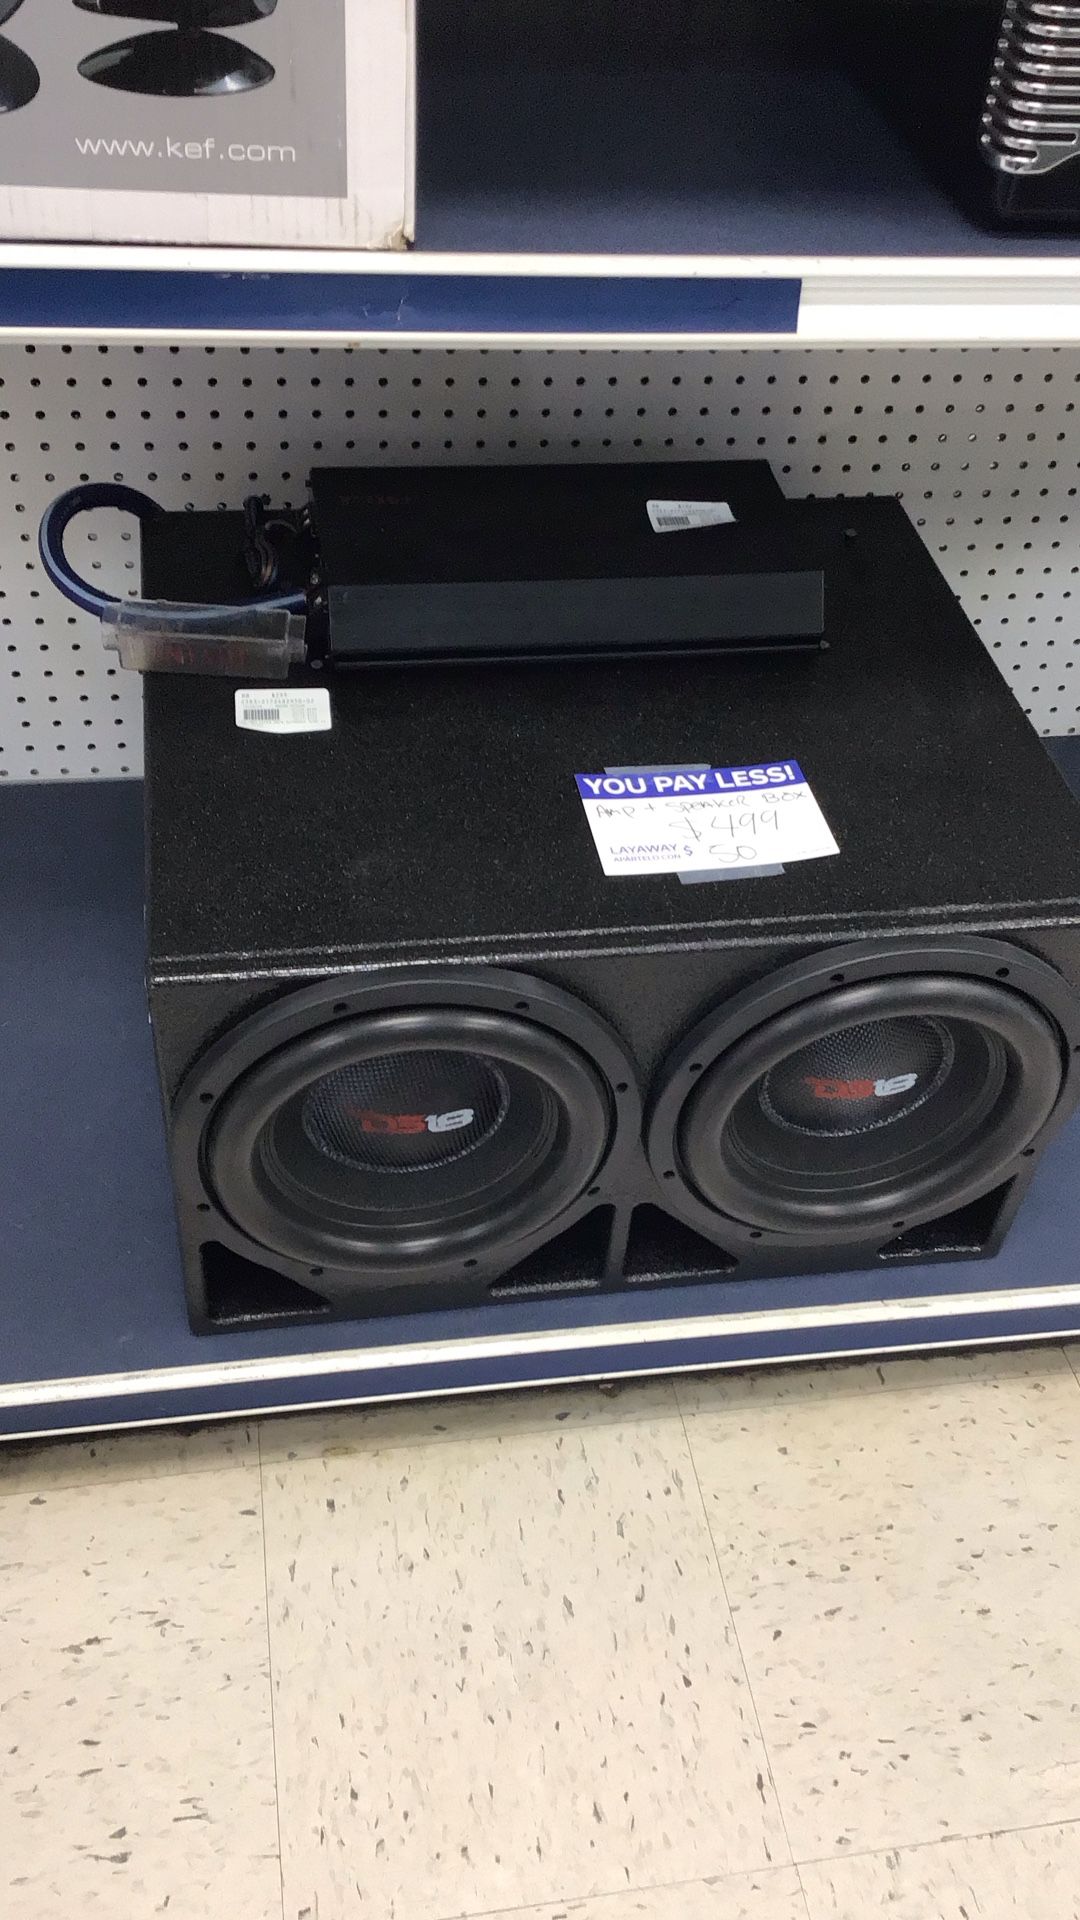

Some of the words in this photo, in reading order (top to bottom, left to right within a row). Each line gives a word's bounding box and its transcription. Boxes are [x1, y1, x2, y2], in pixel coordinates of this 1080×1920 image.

[75, 136, 296, 162] www.kef.com
[583, 777, 647, 795] YOU
[653, 773, 707, 793] PAY
[715, 764, 796, 789] LESS!
[609, 843, 677, 855] LAYAWAY
